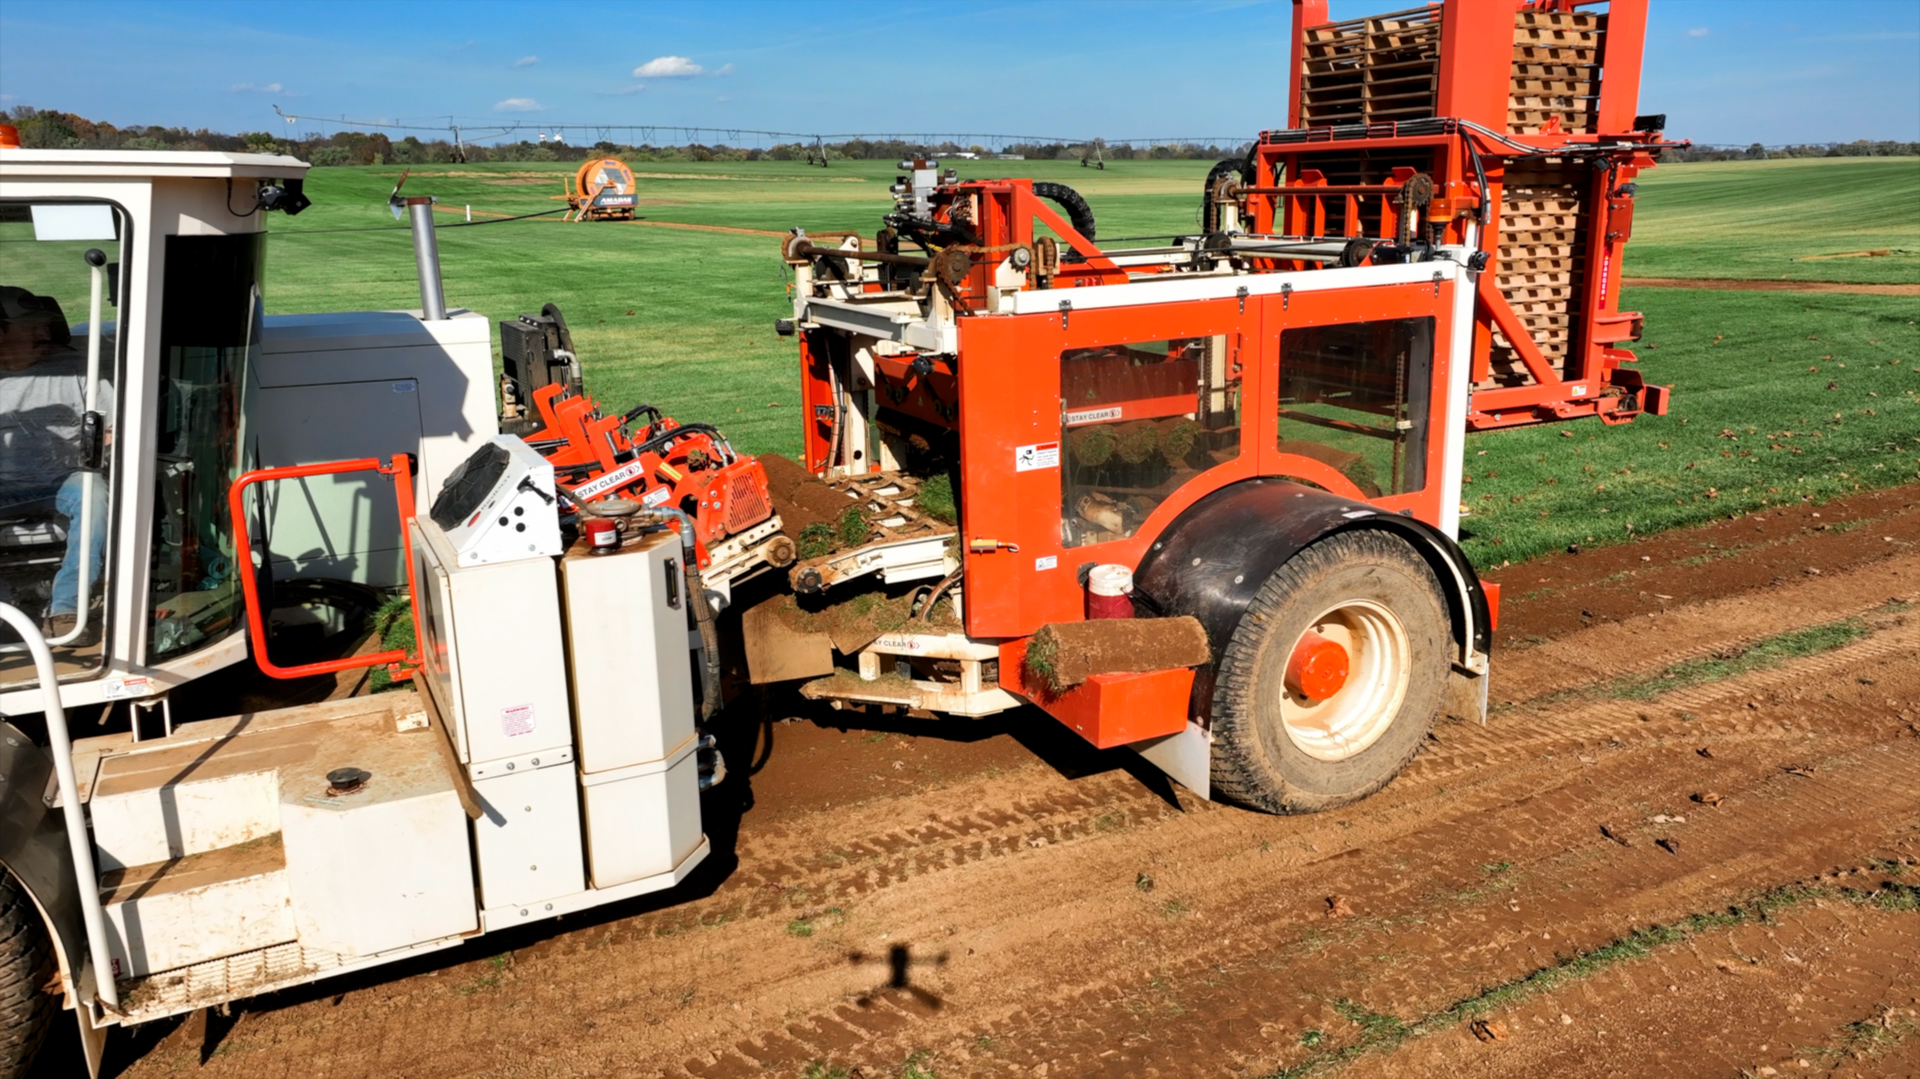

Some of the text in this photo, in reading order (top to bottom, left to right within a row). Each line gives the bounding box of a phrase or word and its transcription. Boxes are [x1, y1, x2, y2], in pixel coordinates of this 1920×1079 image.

[1601, 260, 1609, 295] DANGER
[1072, 411, 1109, 422] STAY CLEAR
[578, 471, 626, 499] STAY CLEAR
[884, 640, 907, 648] CLEAR
